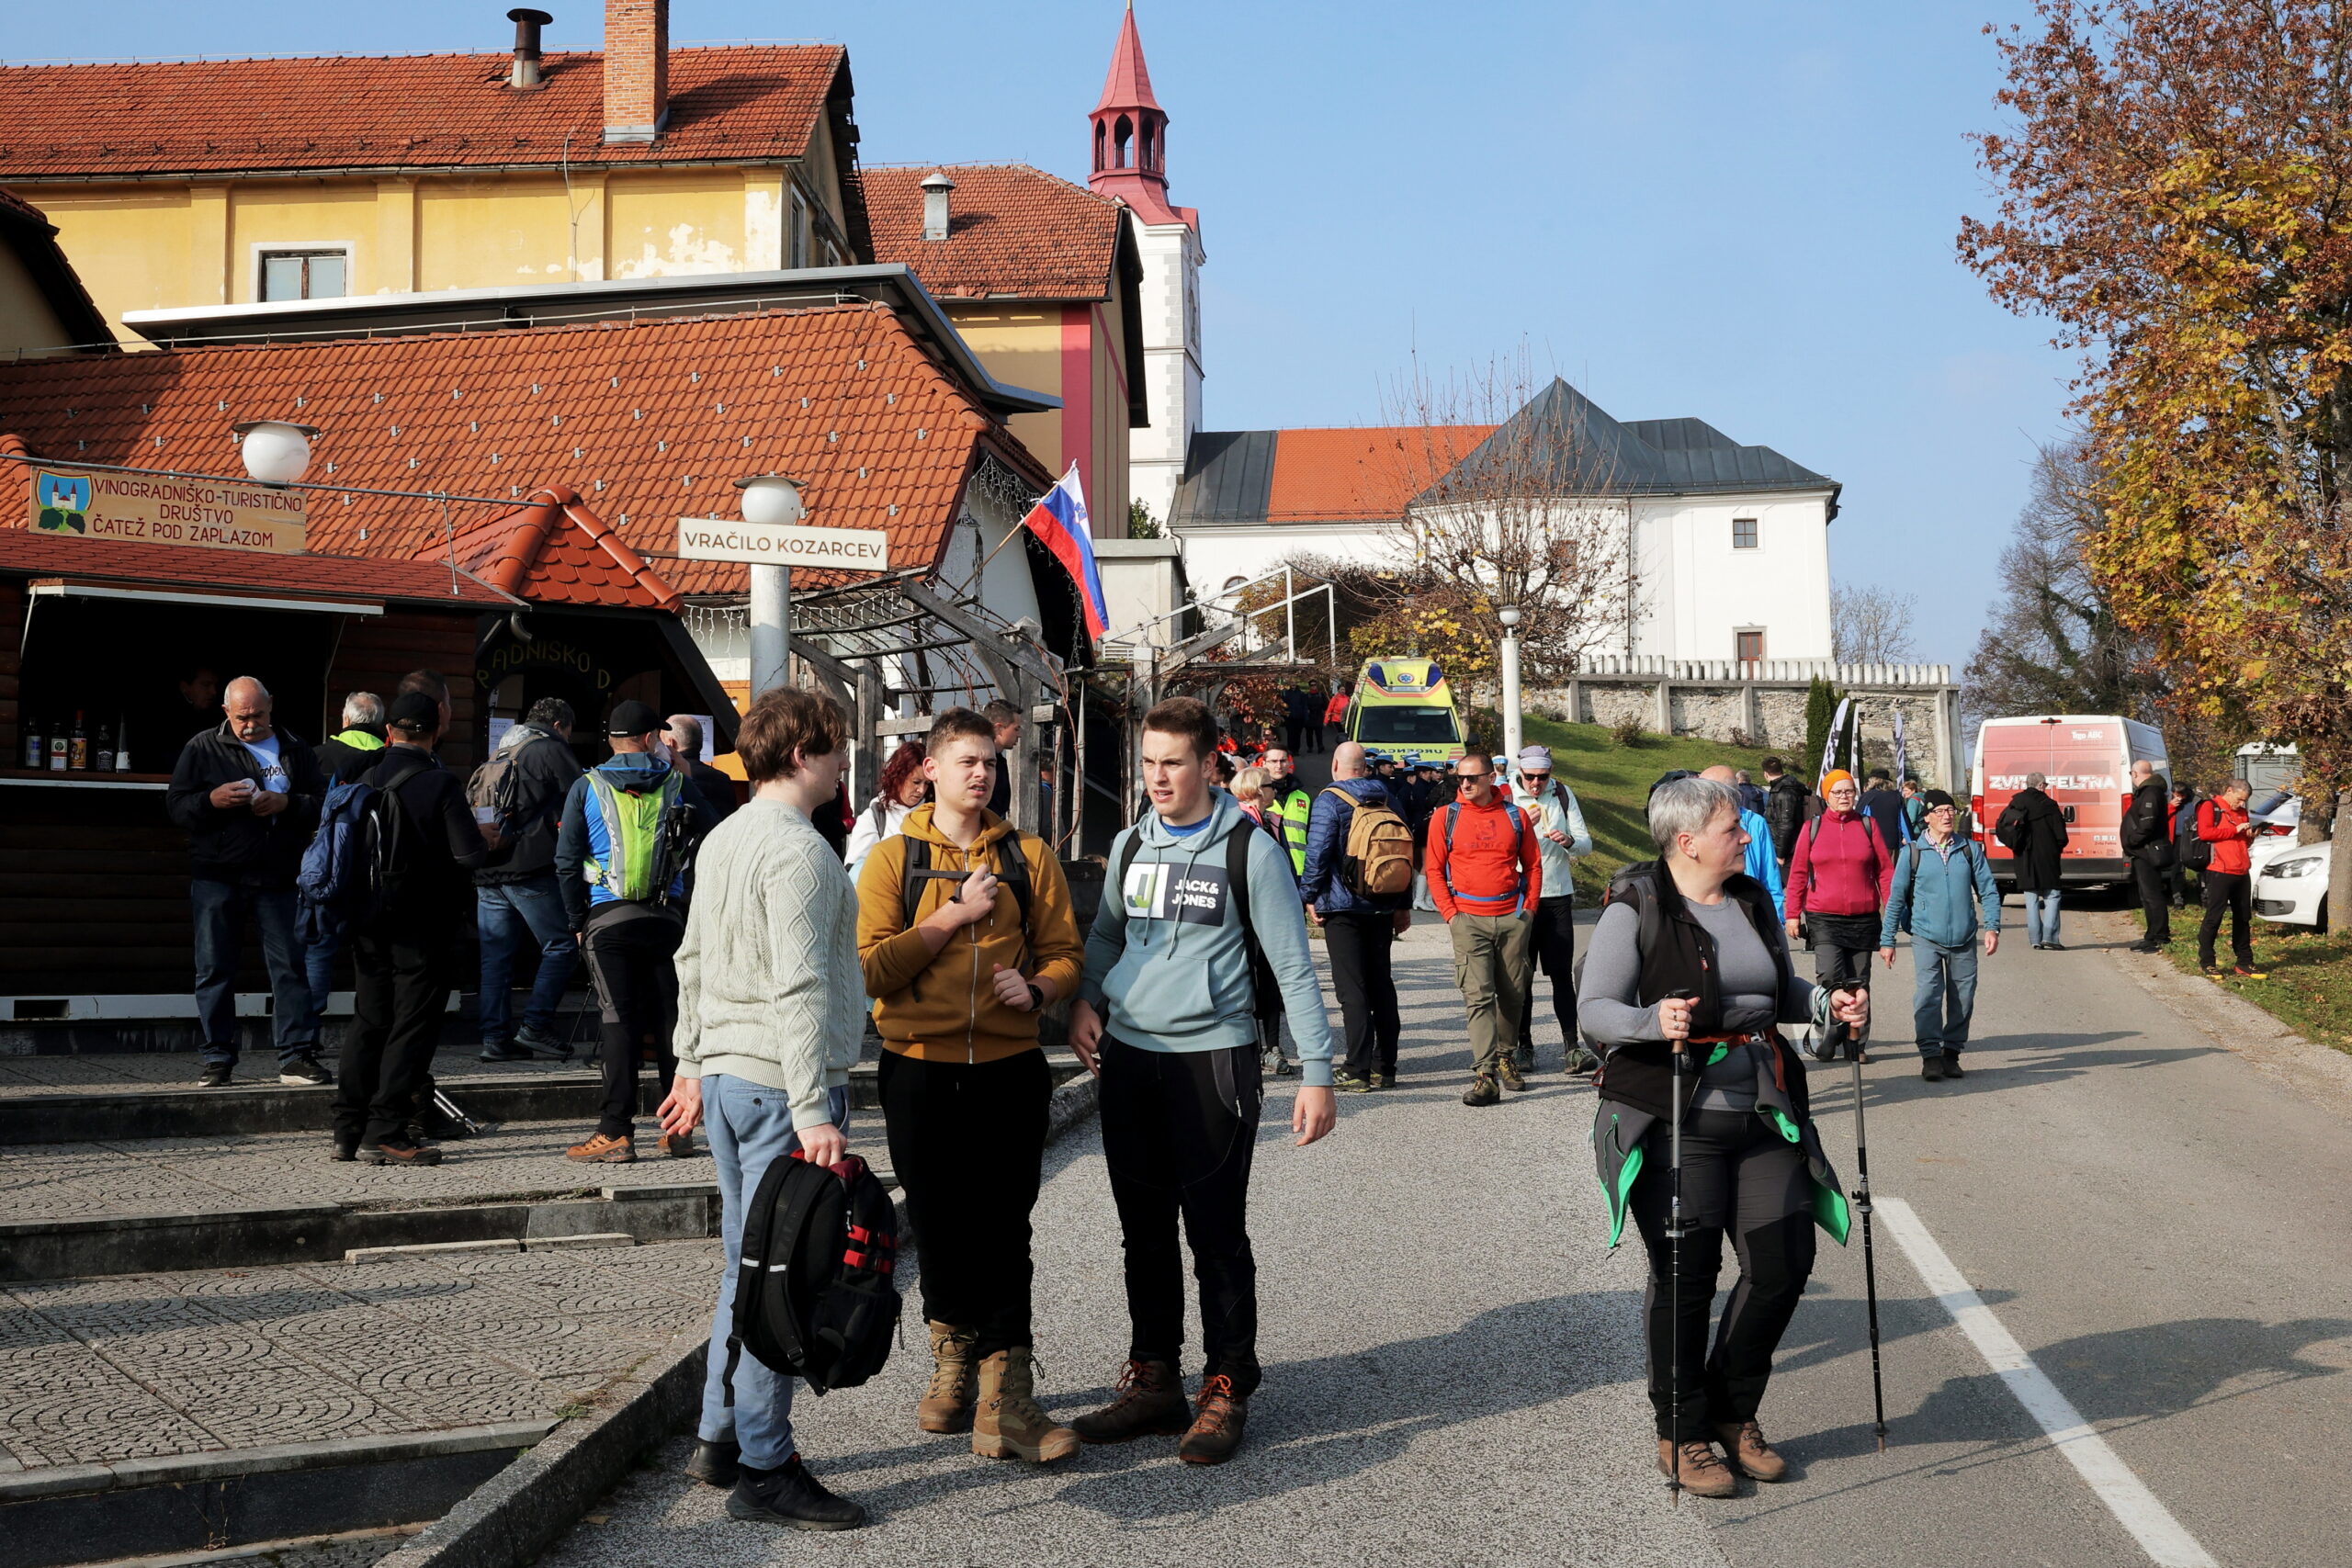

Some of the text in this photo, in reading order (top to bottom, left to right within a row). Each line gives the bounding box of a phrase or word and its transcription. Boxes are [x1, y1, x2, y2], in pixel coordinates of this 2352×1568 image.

[94, 479, 302, 512] VINOGRADNIŠKO-TURISTIČNO
[160, 503, 233, 524] DRUŠTVO
[93, 513, 273, 547] ČATEŽ POD ZAPLAZOM
[684, 531, 882, 558] VRAČILO KOZARCEV
[1988, 775, 2029, 790] ZVIT
[1174, 879, 1219, 895] JACK&
[1171, 894, 1216, 909] JONES
